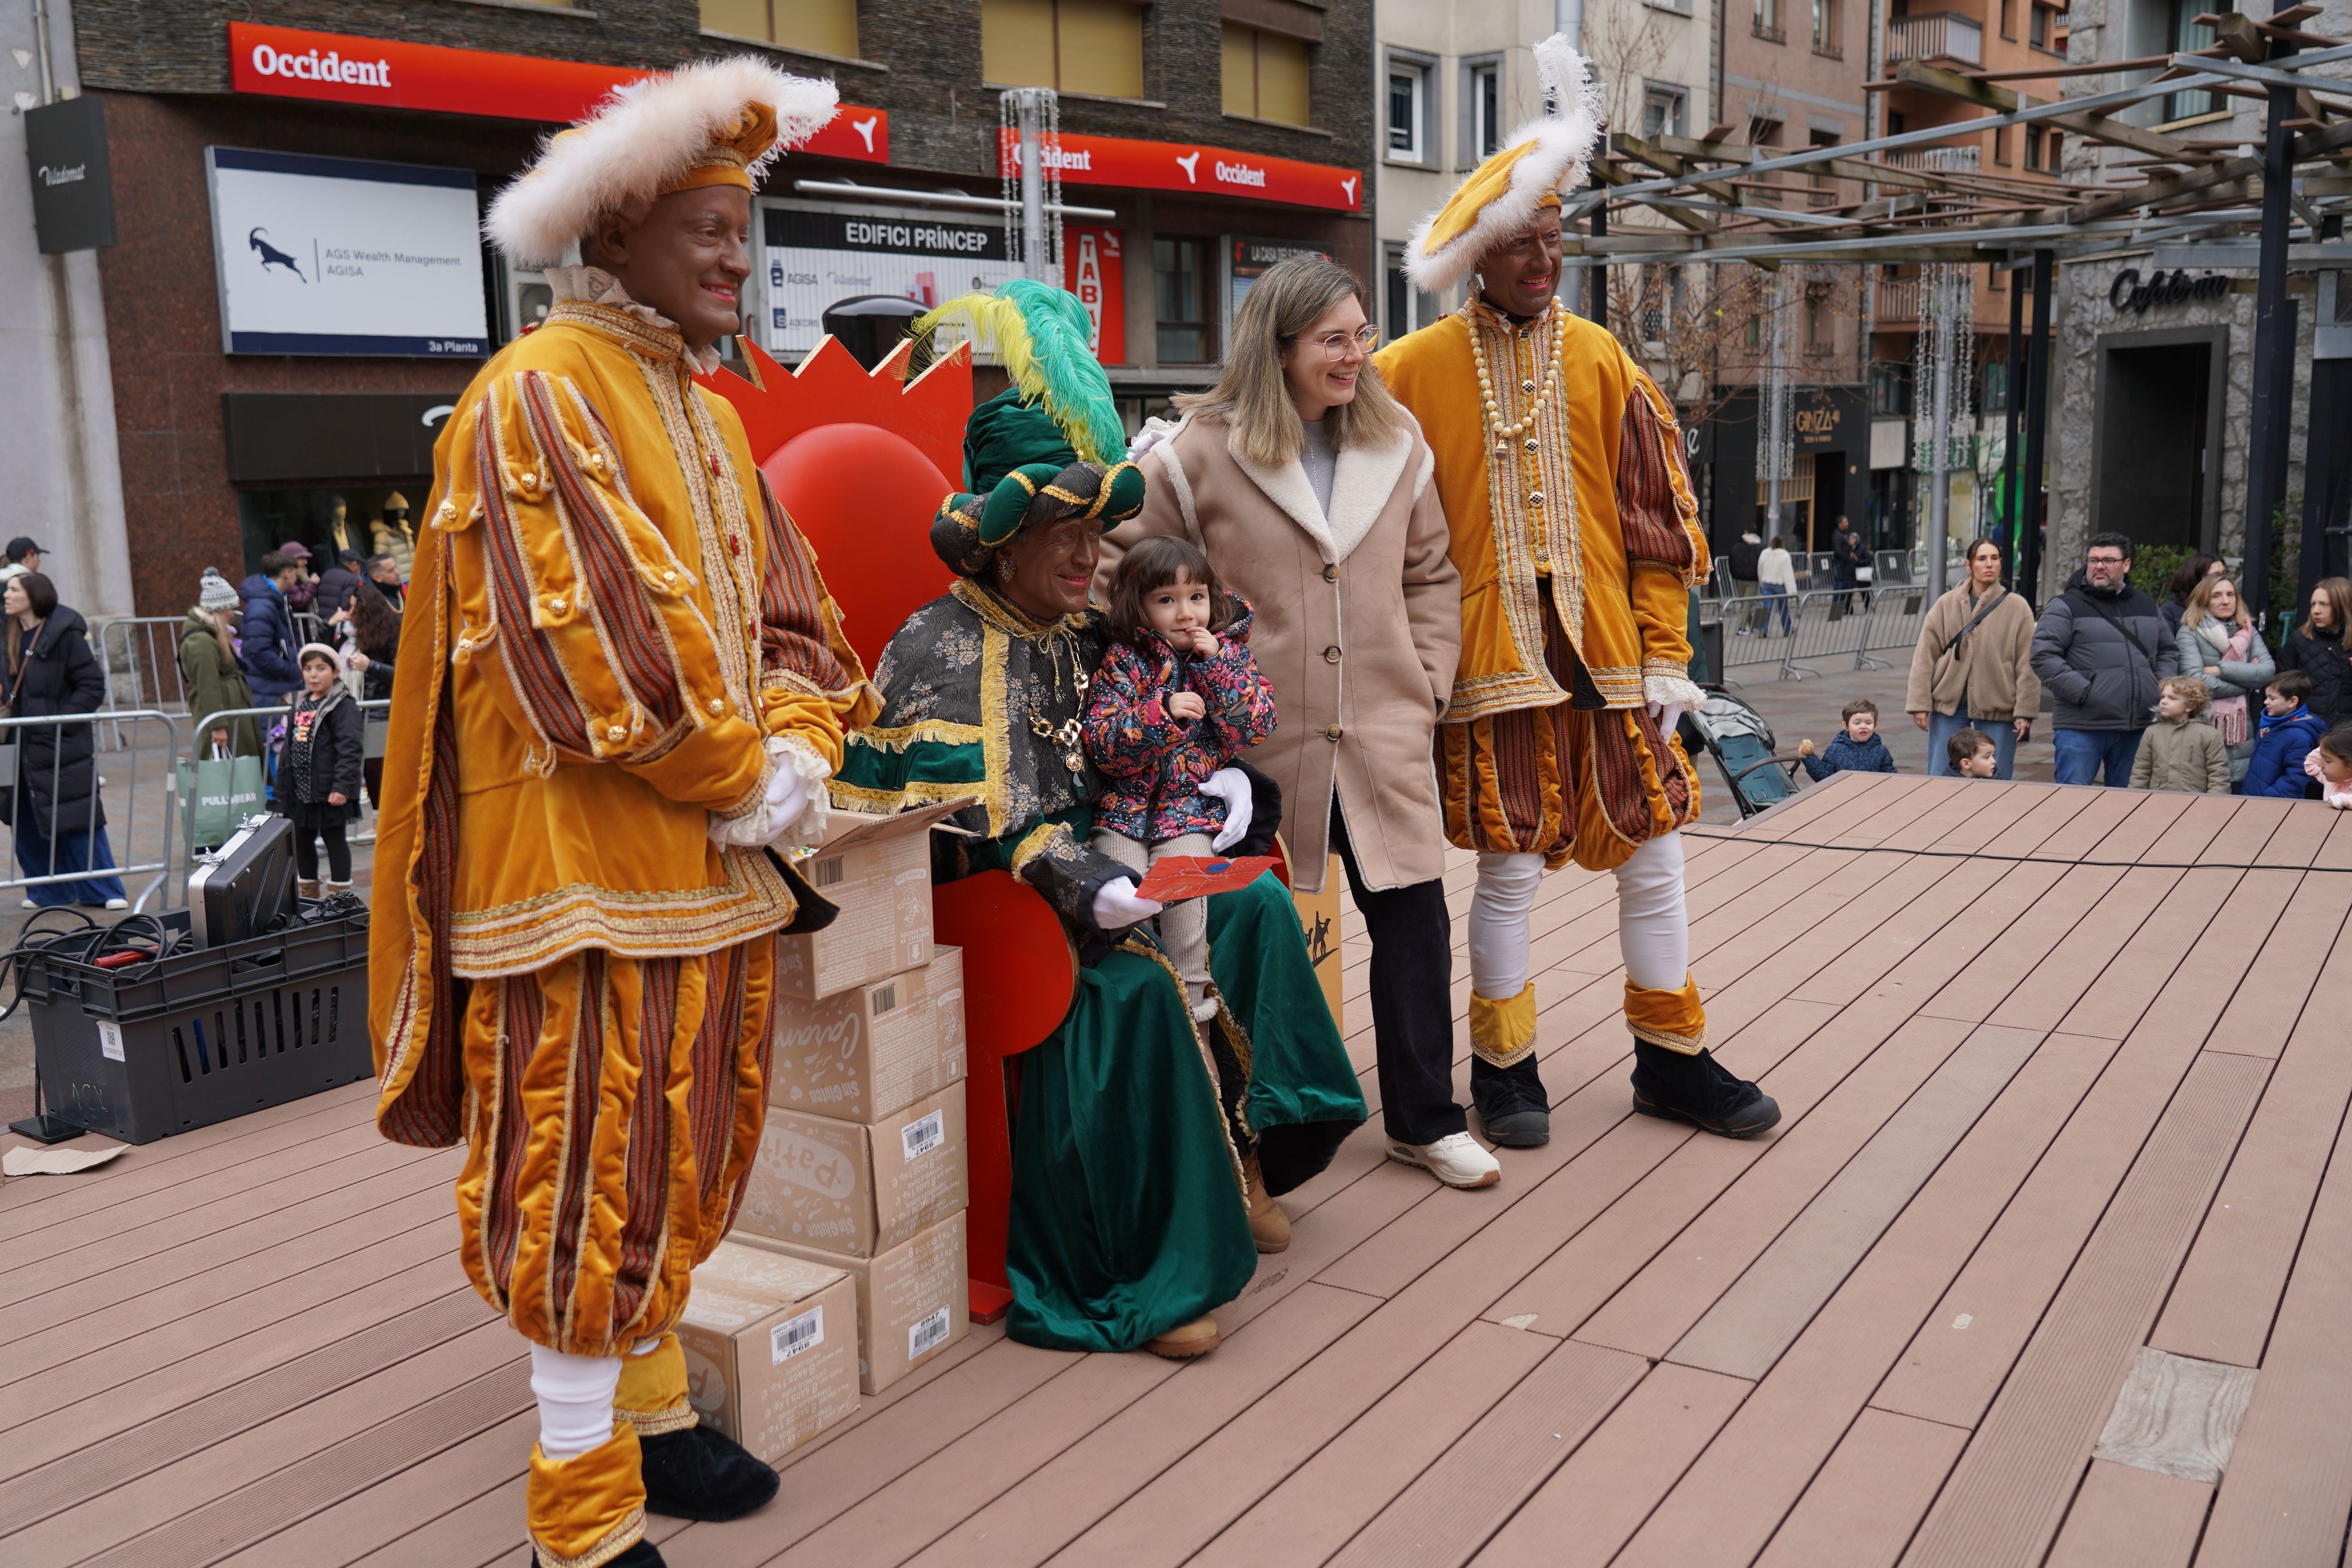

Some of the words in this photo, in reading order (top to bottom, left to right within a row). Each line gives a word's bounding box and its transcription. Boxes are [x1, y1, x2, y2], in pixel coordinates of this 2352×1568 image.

[253, 44, 391, 87] Occident
[1014, 143, 1092, 171] Ocident
[1215, 161, 1266, 187] Occident
[846, 222, 911, 247] EDIFICI
[914, 225, 988, 252] PRÍNCEP
[326, 249, 350, 259] AGS
[354, 251, 391, 262] Wealth
[394, 253, 460, 267] Management
[327, 265, 364, 276] AGISA
[788, 272, 818, 285] AGISA
[427, 340, 442, 352] 3a
[444, 341, 478, 353] Planta
[916, 1142, 933, 1155] 8947
[914, 1162, 928, 1175] BAGS
[929, 1159, 934, 1168] 8
[932, 1176, 936, 1186] 8
[908, 1247, 914, 1258] 8
[915, 1237, 937, 1255] BOLSAS
[939, 1233, 942, 1241] 1
[901, 1251, 928, 1270] CARAMELOS
[914, 1263, 919, 1274] 8
[921, 1254, 940, 1270] SACOS
[914, 1281, 920, 1293] 8
[921, 1276, 936, 1290] SACS
[916, 1300, 921, 1310] 8
[923, 1293, 938, 1307] BAGS
[924, 1300, 940, 1313] CANDY
[921, 1312, 939, 1327] 8947
[787, 1341, 810, 1358] 8947
[806, 1352, 822, 1364] HARD
[786, 1361, 805, 1376] CANDY
[809, 1364, 815, 1374] 8
[789, 1369, 807, 1383] BAGS
[798, 1368, 827, 1389] CARAMELS
[783, 1379, 787, 1388] 1
[811, 1382, 817, 1394] 8
[792, 1386, 810, 1402] SACS
[811, 1402, 817, 1413] 8
[786, 1406, 810, 1425] SACOS
[780, 1421, 784, 1429] 1
[816, 1418, 822, 1429] 8
[788, 1422, 814, 1444] BOLSAS
[782, 1440, 785, 1449] 1
